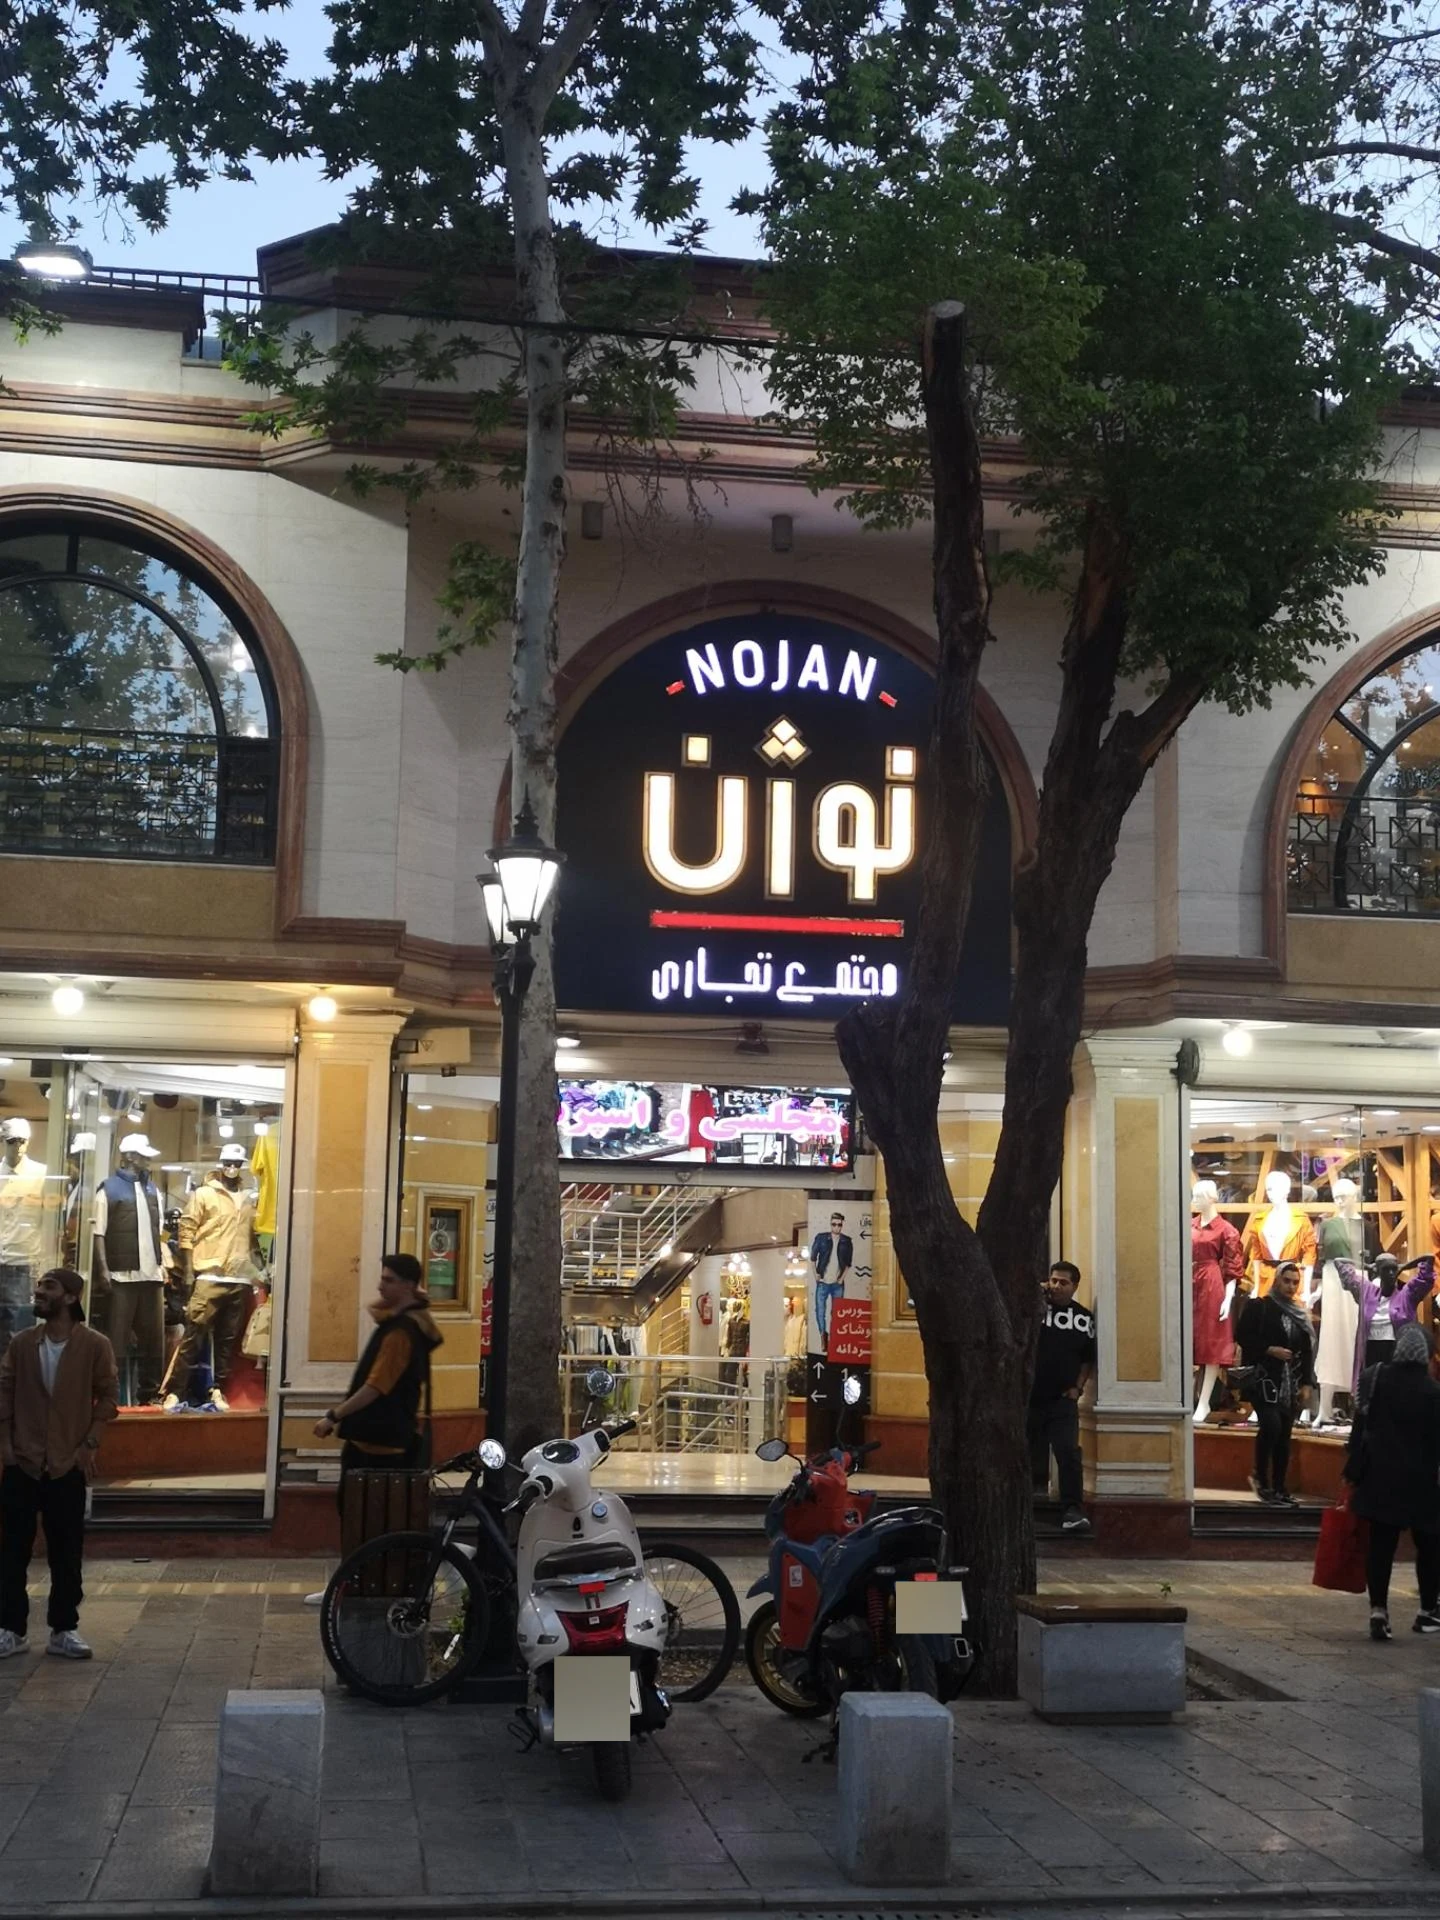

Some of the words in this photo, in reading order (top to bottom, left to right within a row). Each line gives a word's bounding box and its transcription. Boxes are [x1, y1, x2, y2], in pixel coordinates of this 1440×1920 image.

[685, 640, 877, 701] NOJAN
[652, 946, 773, 1003] تجاری
[776, 954, 898, 1005] مجتمع
[557, 1091, 652, 1138] اسپر
[661, 1109, 689, 1138] و
[700, 1100, 839, 1142] مجلسی
[836, 1322, 872, 1338] وشاک
[837, 1307, 872, 1318] ورس
[836, 1343, 872, 1357] ردانه
